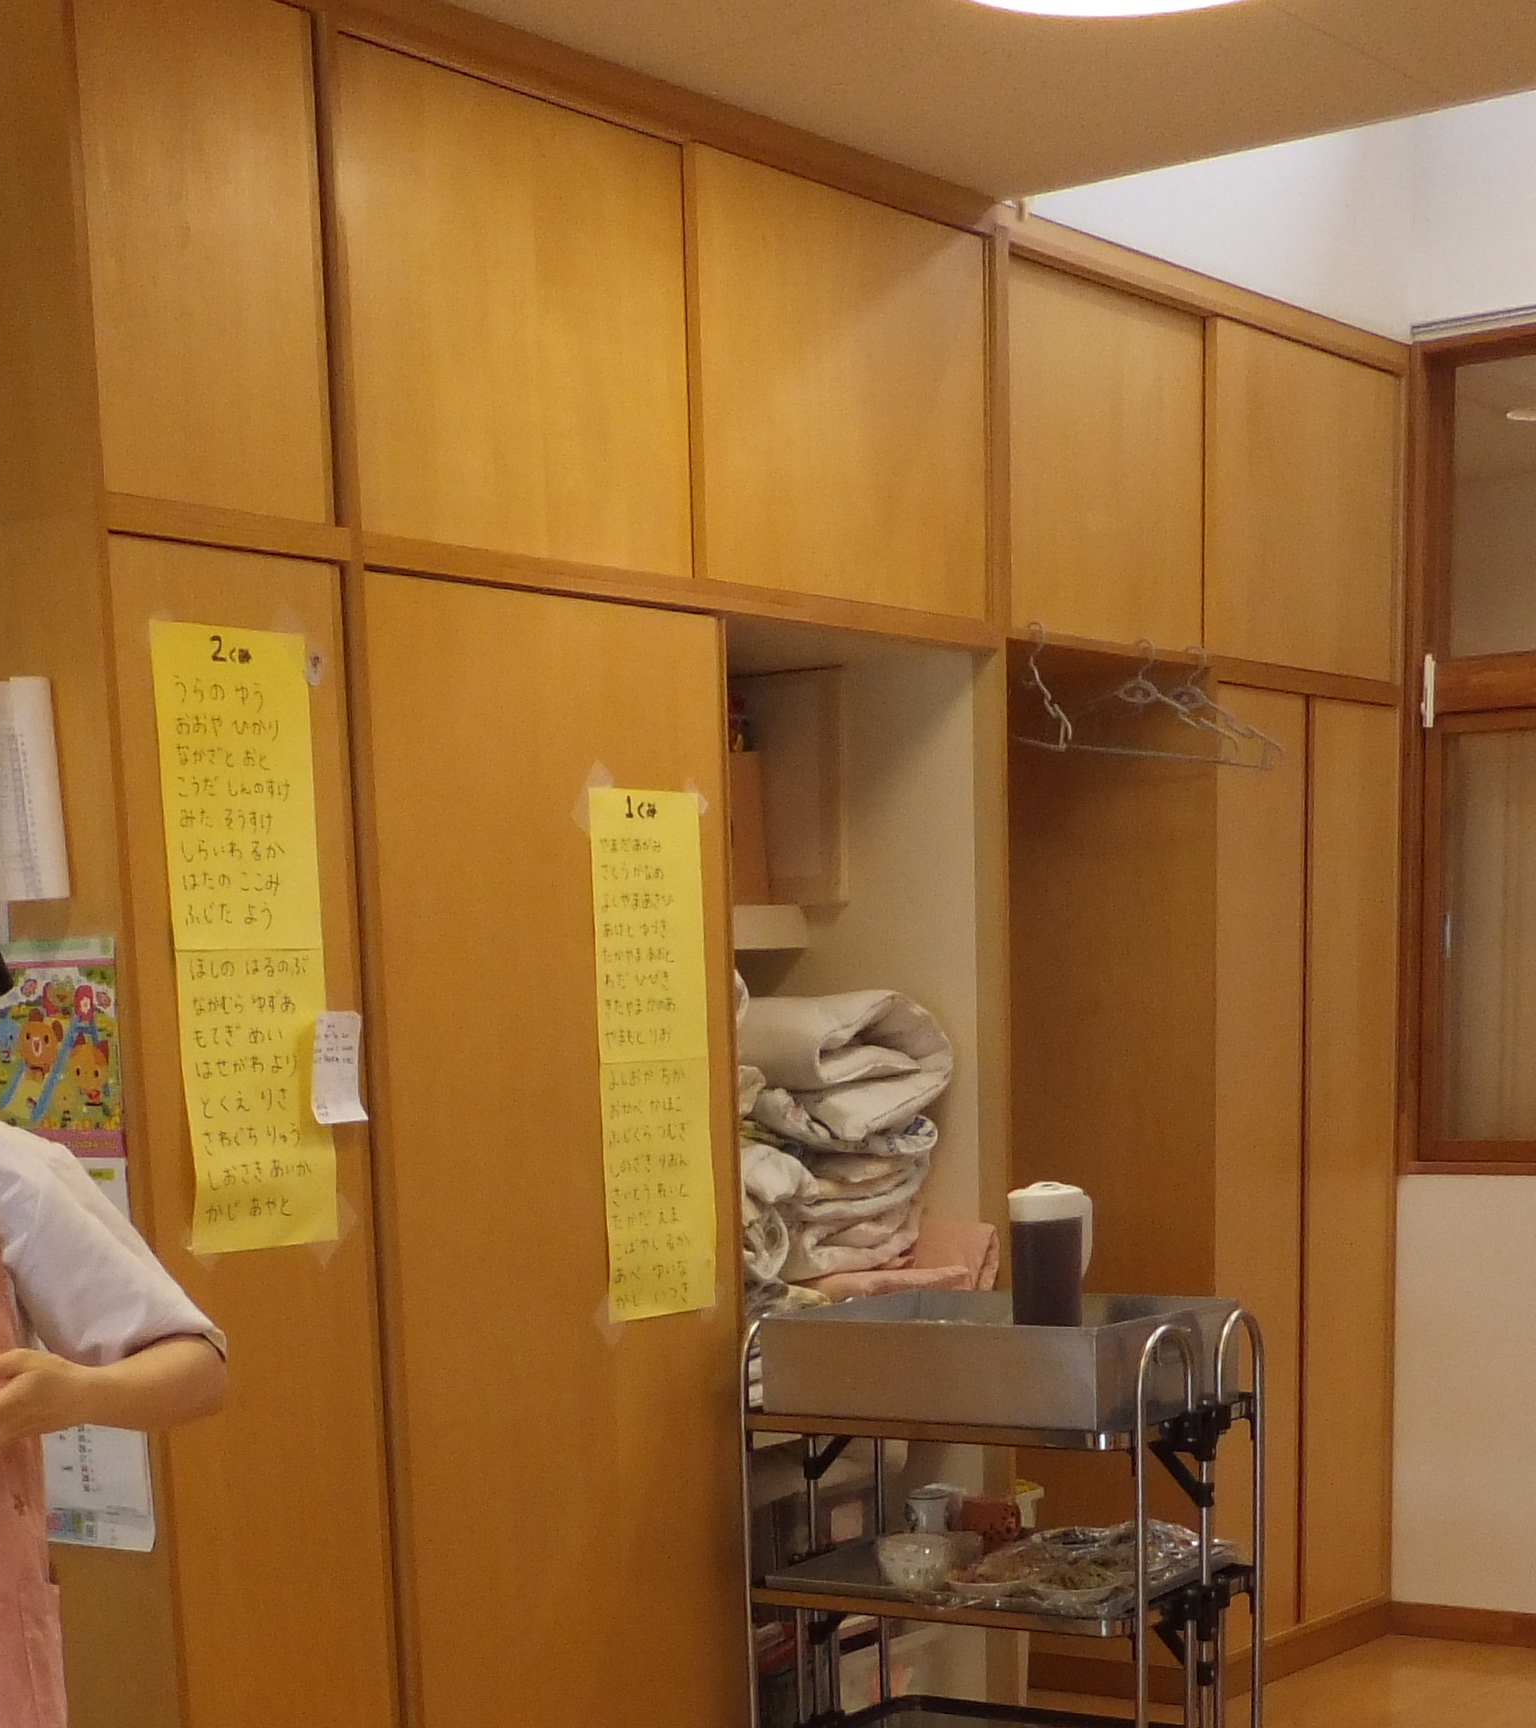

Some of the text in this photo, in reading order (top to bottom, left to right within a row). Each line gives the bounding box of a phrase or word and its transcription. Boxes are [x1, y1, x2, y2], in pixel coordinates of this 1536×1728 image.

[173, 675, 264, 713] うらの ゆう
[176, 713, 279, 741] おおや ひかり
[244, 748, 270, 771] おと
[177, 775, 290, 802] こうだ しんのすけ
[180, 808, 273, 835] みた そうすけ
[181, 840, 285, 863] しらいわ るか
[182, 871, 281, 896] はたの ここみ
[185, 901, 272, 930] ふじた よう
[189, 955, 309, 981] ほしの はるのぶ
[252, 989, 296, 1014] ゆずあ
[193, 1024, 283, 1048] もてぎ めい
[195, 1055, 297, 1079] はせがわ より
[201, 1090, 250, 1119] とくえ
[260, 1087, 288, 1111] りさ
[202, 1123, 301, 1156] さわぐち りゅう
[207, 1159, 312, 1191] しおさき あいか
[249, 1197, 293, 1217] あやと
